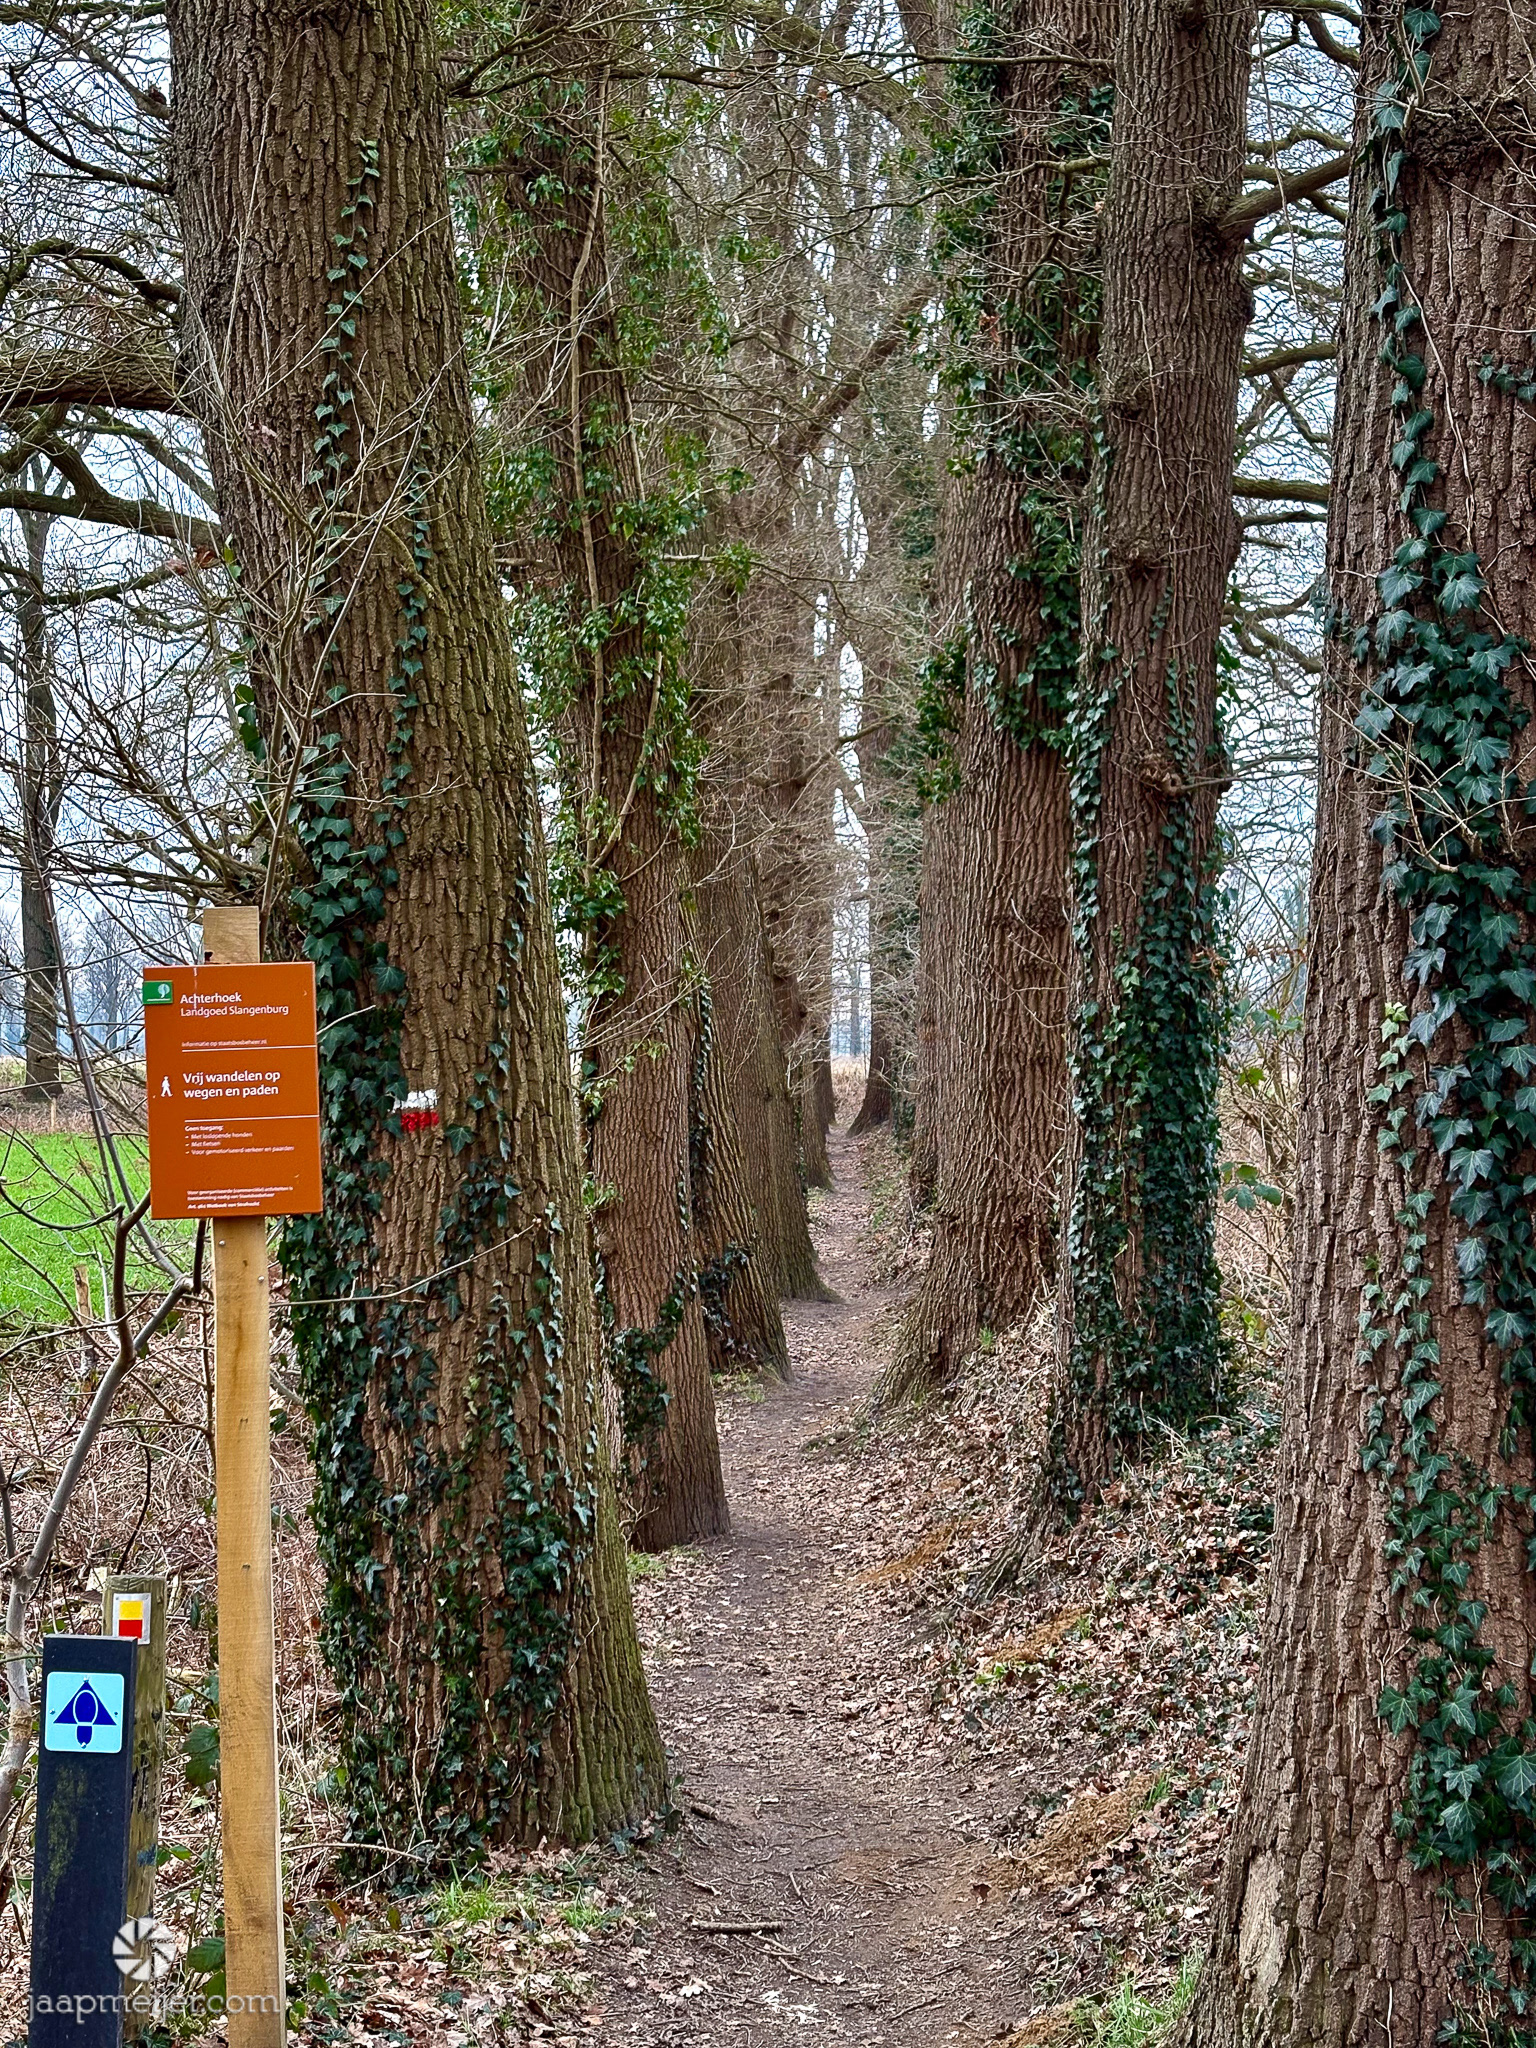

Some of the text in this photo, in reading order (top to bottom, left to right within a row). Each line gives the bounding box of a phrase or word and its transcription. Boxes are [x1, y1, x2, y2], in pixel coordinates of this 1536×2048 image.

[180, 992, 242, 1004] Achterhoek
[180, 1004, 289, 1018] Landgoed Slangenburg
[183, 1070, 281, 1086] Vrij wandelen op
[183, 1084, 279, 1100] wegen en paden
